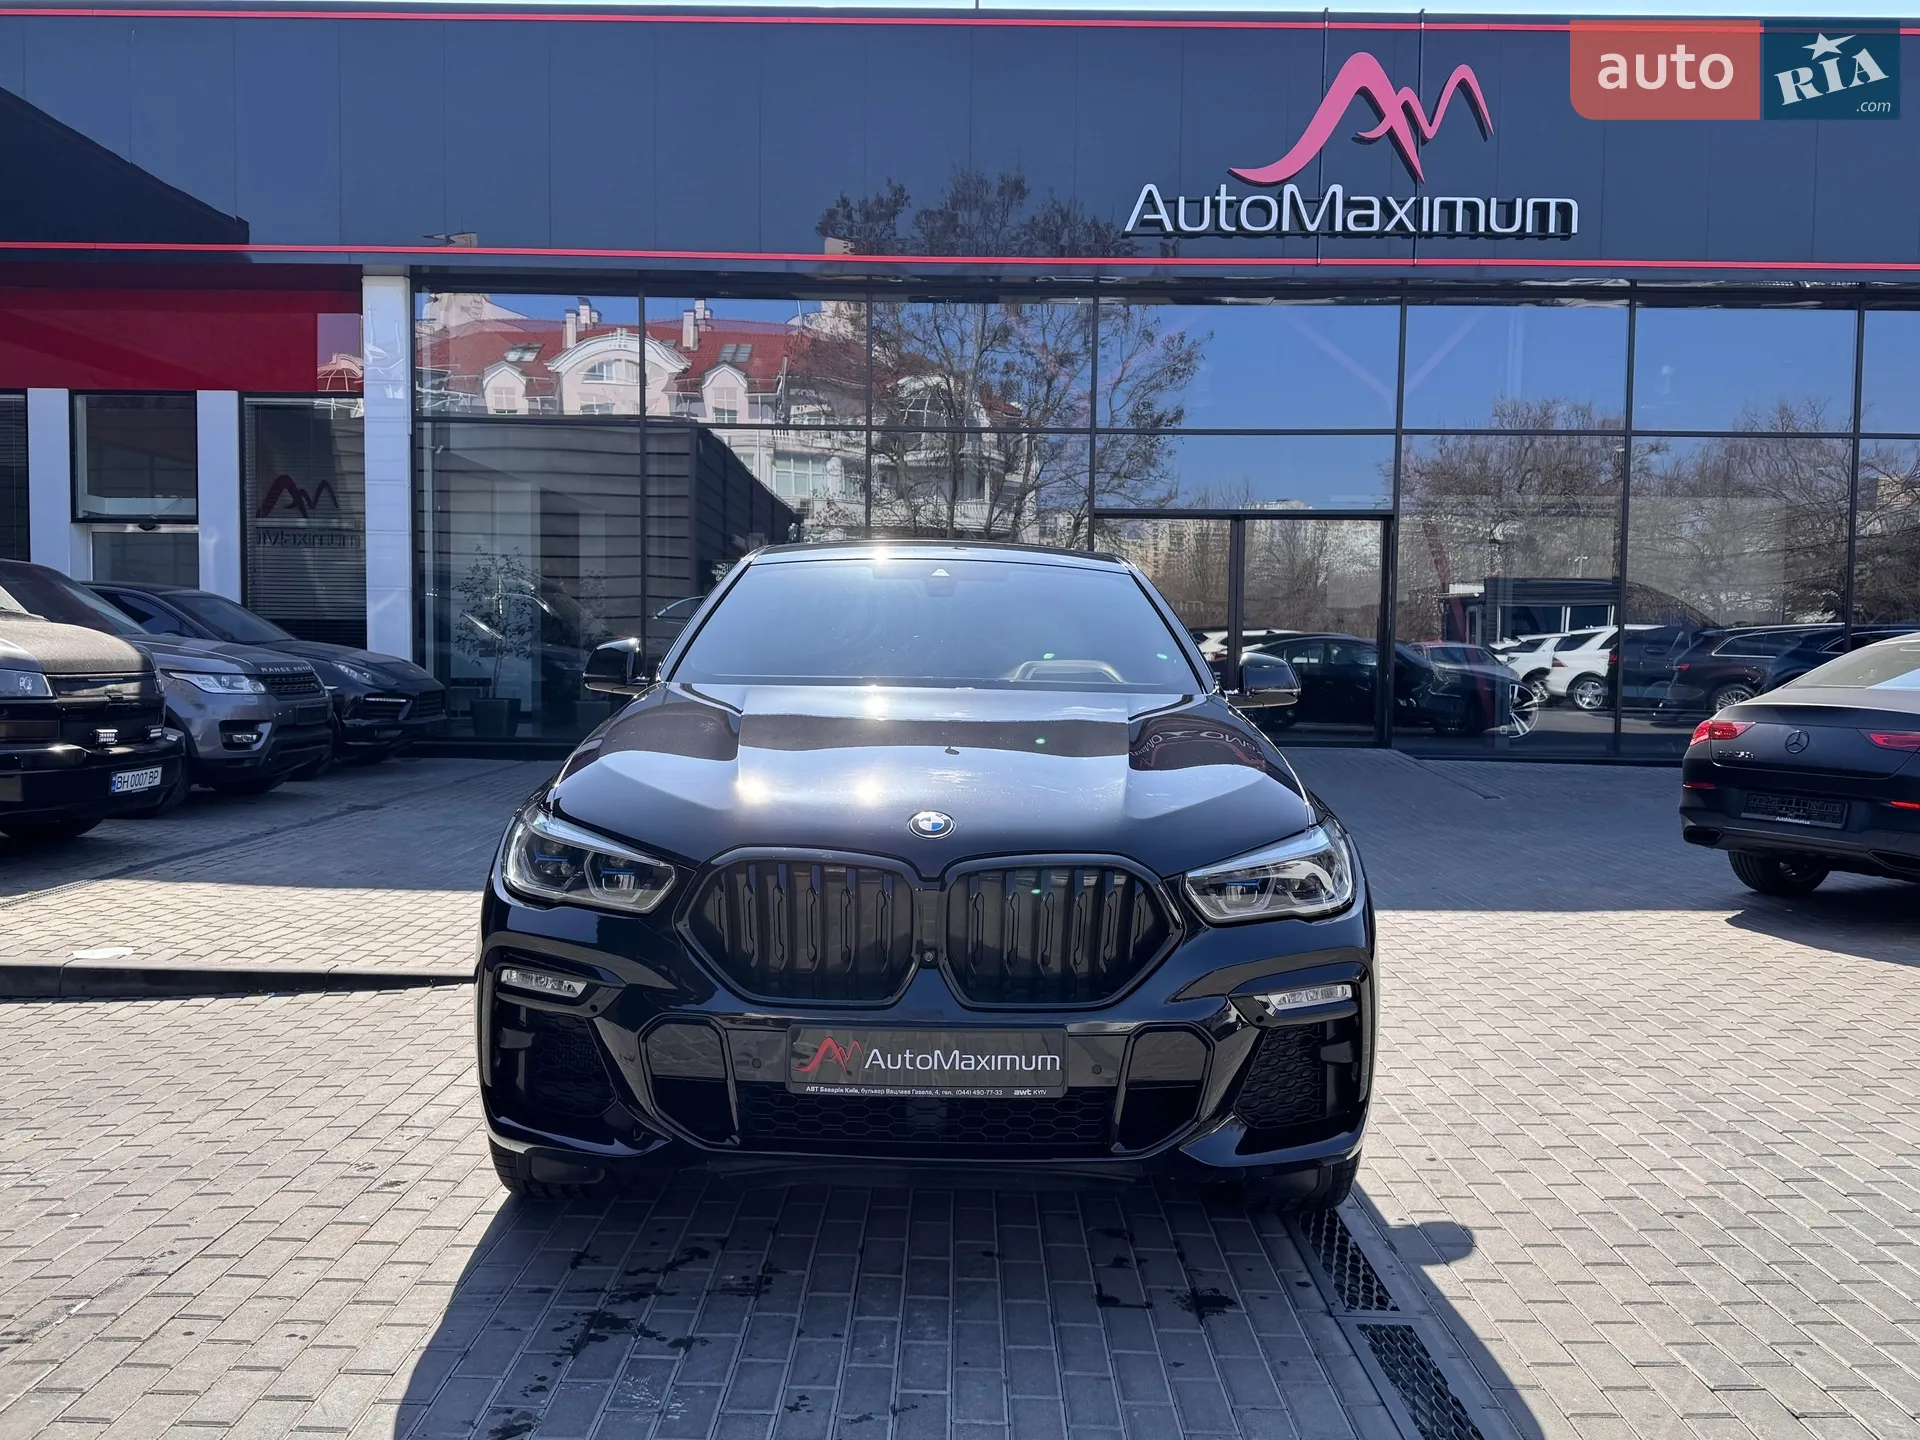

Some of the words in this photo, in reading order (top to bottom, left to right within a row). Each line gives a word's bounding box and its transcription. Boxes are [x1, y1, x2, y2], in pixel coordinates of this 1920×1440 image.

[1124, 183, 1580, 235] AutoMaximum
[116, 775, 129, 790] BH
[130, 772, 148, 788] 0007
[148, 770, 159, 785] BP
[864, 1048, 1060, 1071] AutoMaximum
[1013, 1088, 1032, 1096] awt
